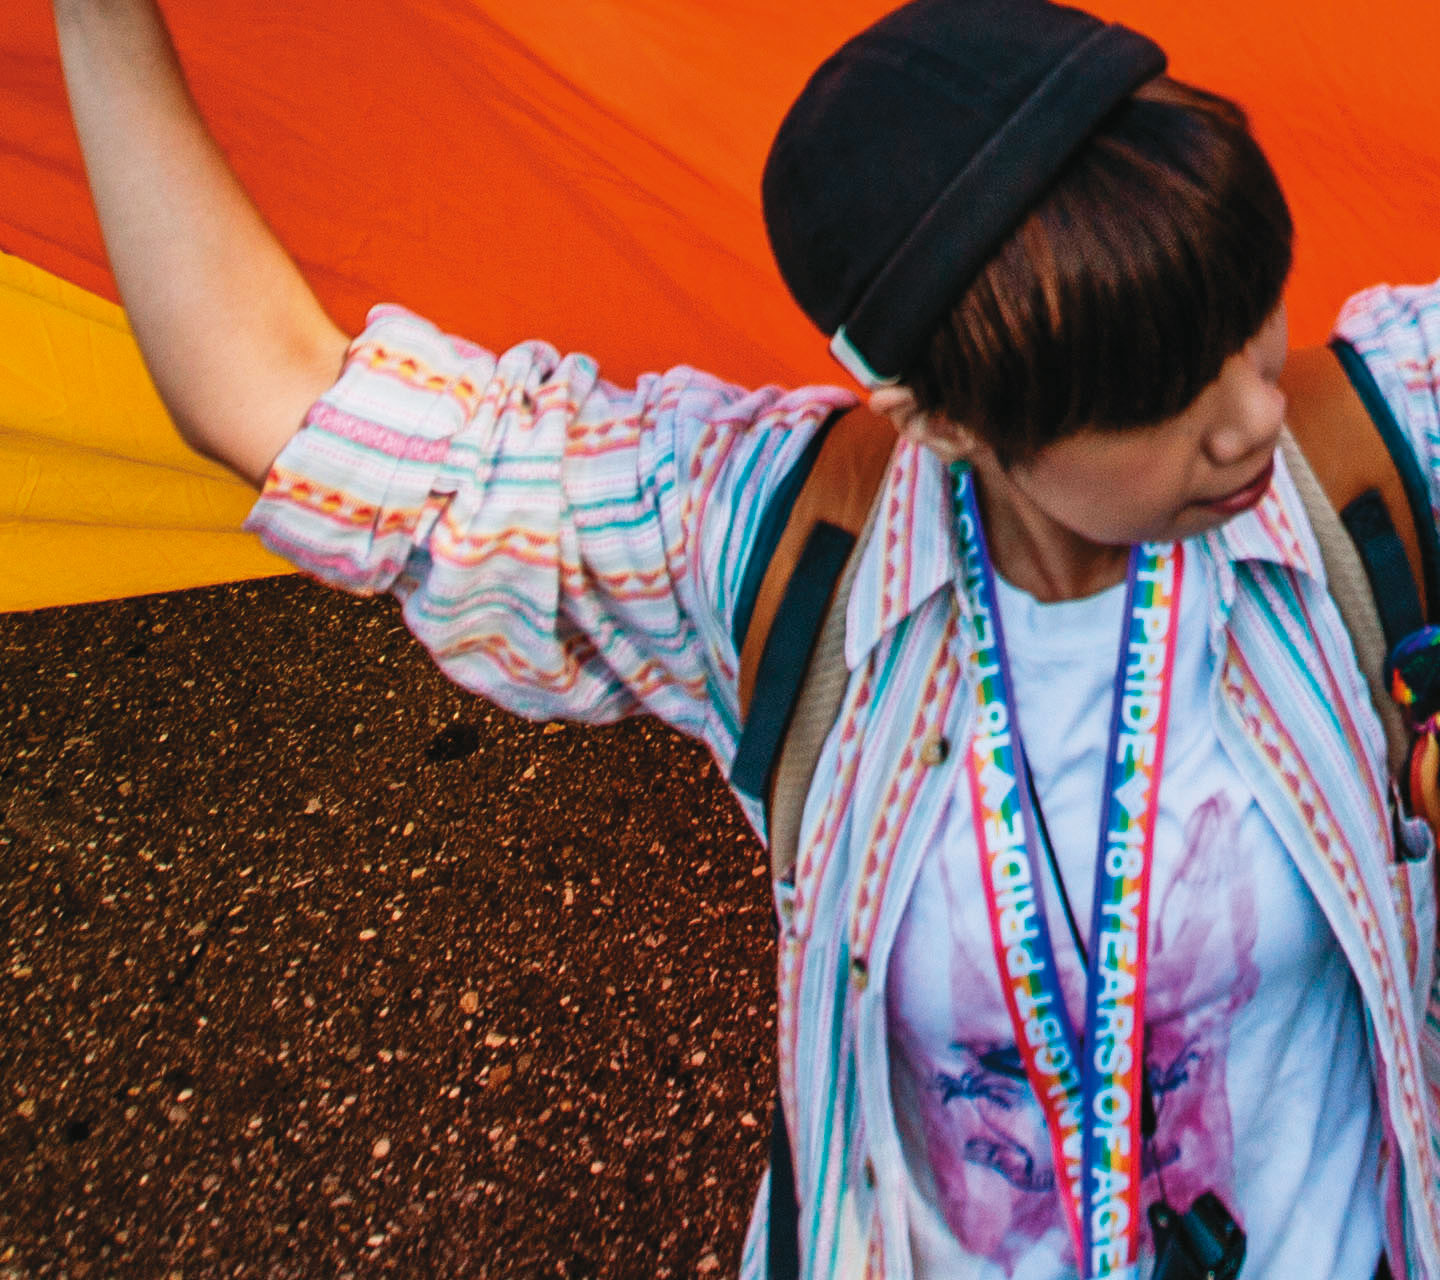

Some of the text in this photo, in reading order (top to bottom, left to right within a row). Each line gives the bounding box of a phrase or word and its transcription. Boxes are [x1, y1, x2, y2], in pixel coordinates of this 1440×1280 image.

[1116, 606, 1172, 765] PRIDE
[984, 811, 1046, 979] PRIDE
[1105, 829, 1145, 880] 18
[1092, 890, 1143, 1077] YEARS
[1092, 1086, 1133, 1158] OF
[1089, 1166, 1132, 1278] AGE
